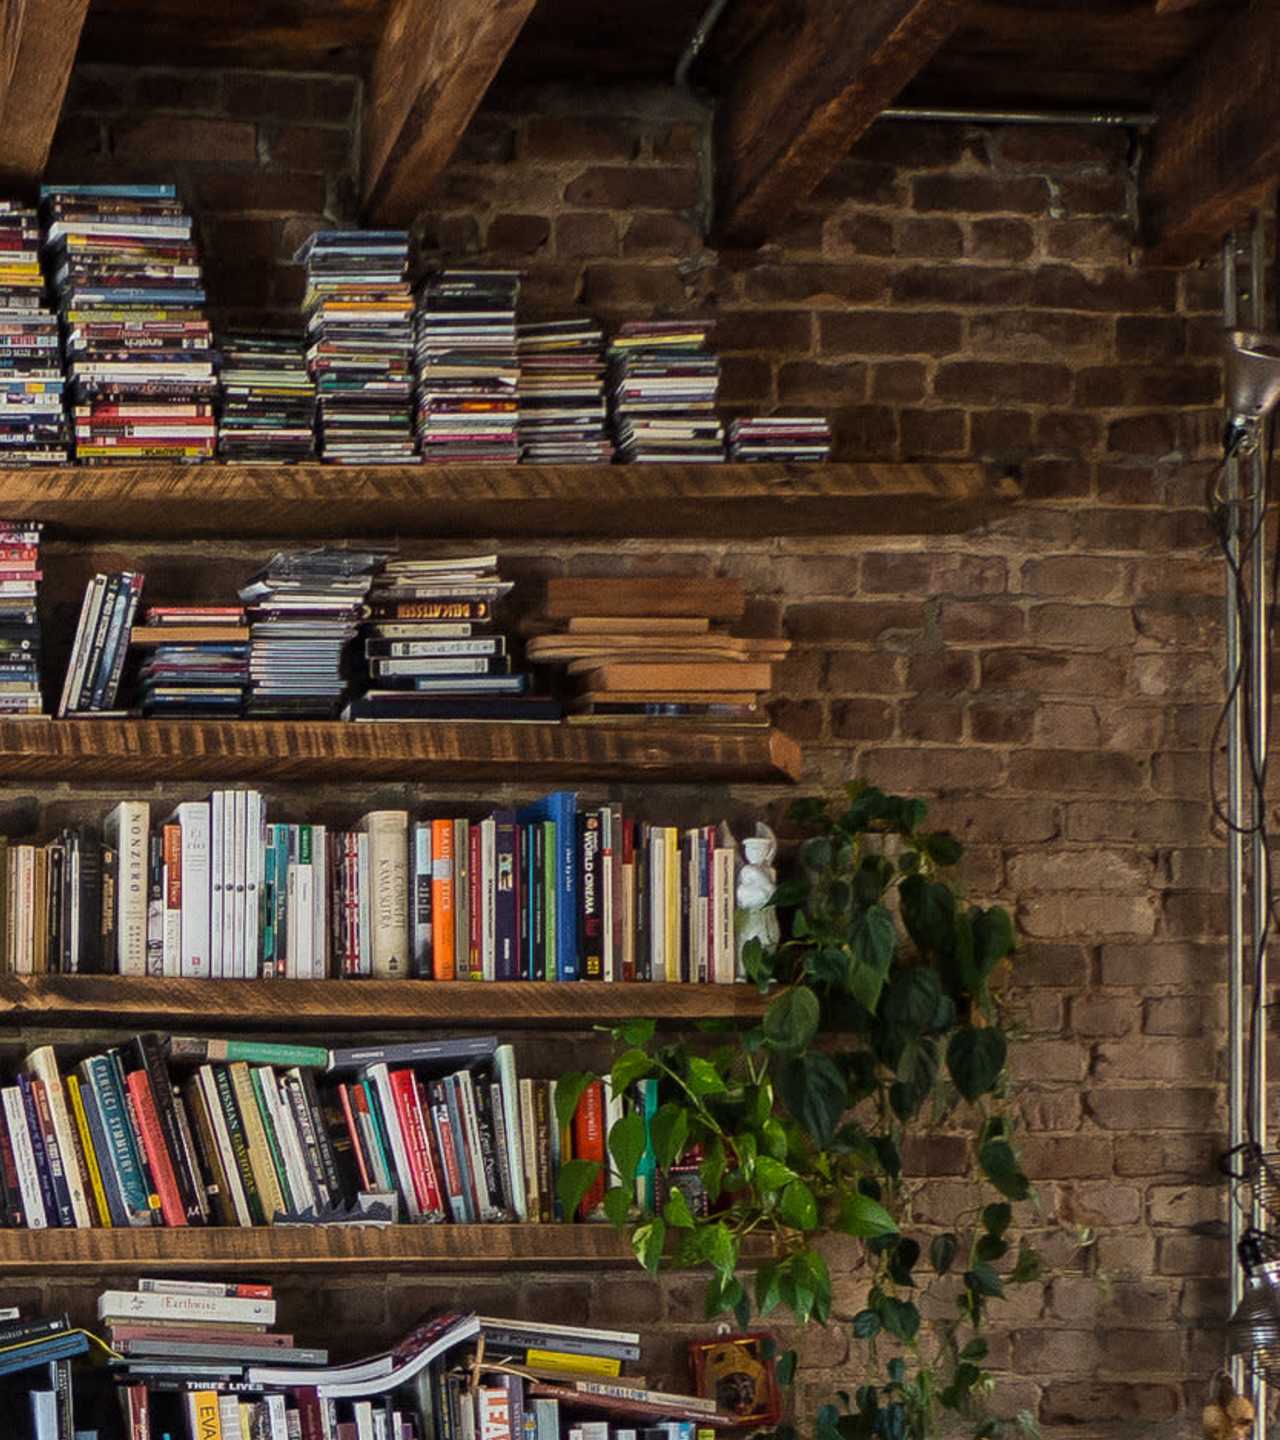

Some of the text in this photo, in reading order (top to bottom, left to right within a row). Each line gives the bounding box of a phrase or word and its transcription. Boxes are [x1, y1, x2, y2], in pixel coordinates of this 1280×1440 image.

[186, 1381, 263, 1392] THREE LIVES
[200, 1406, 215, 1440] EVA
